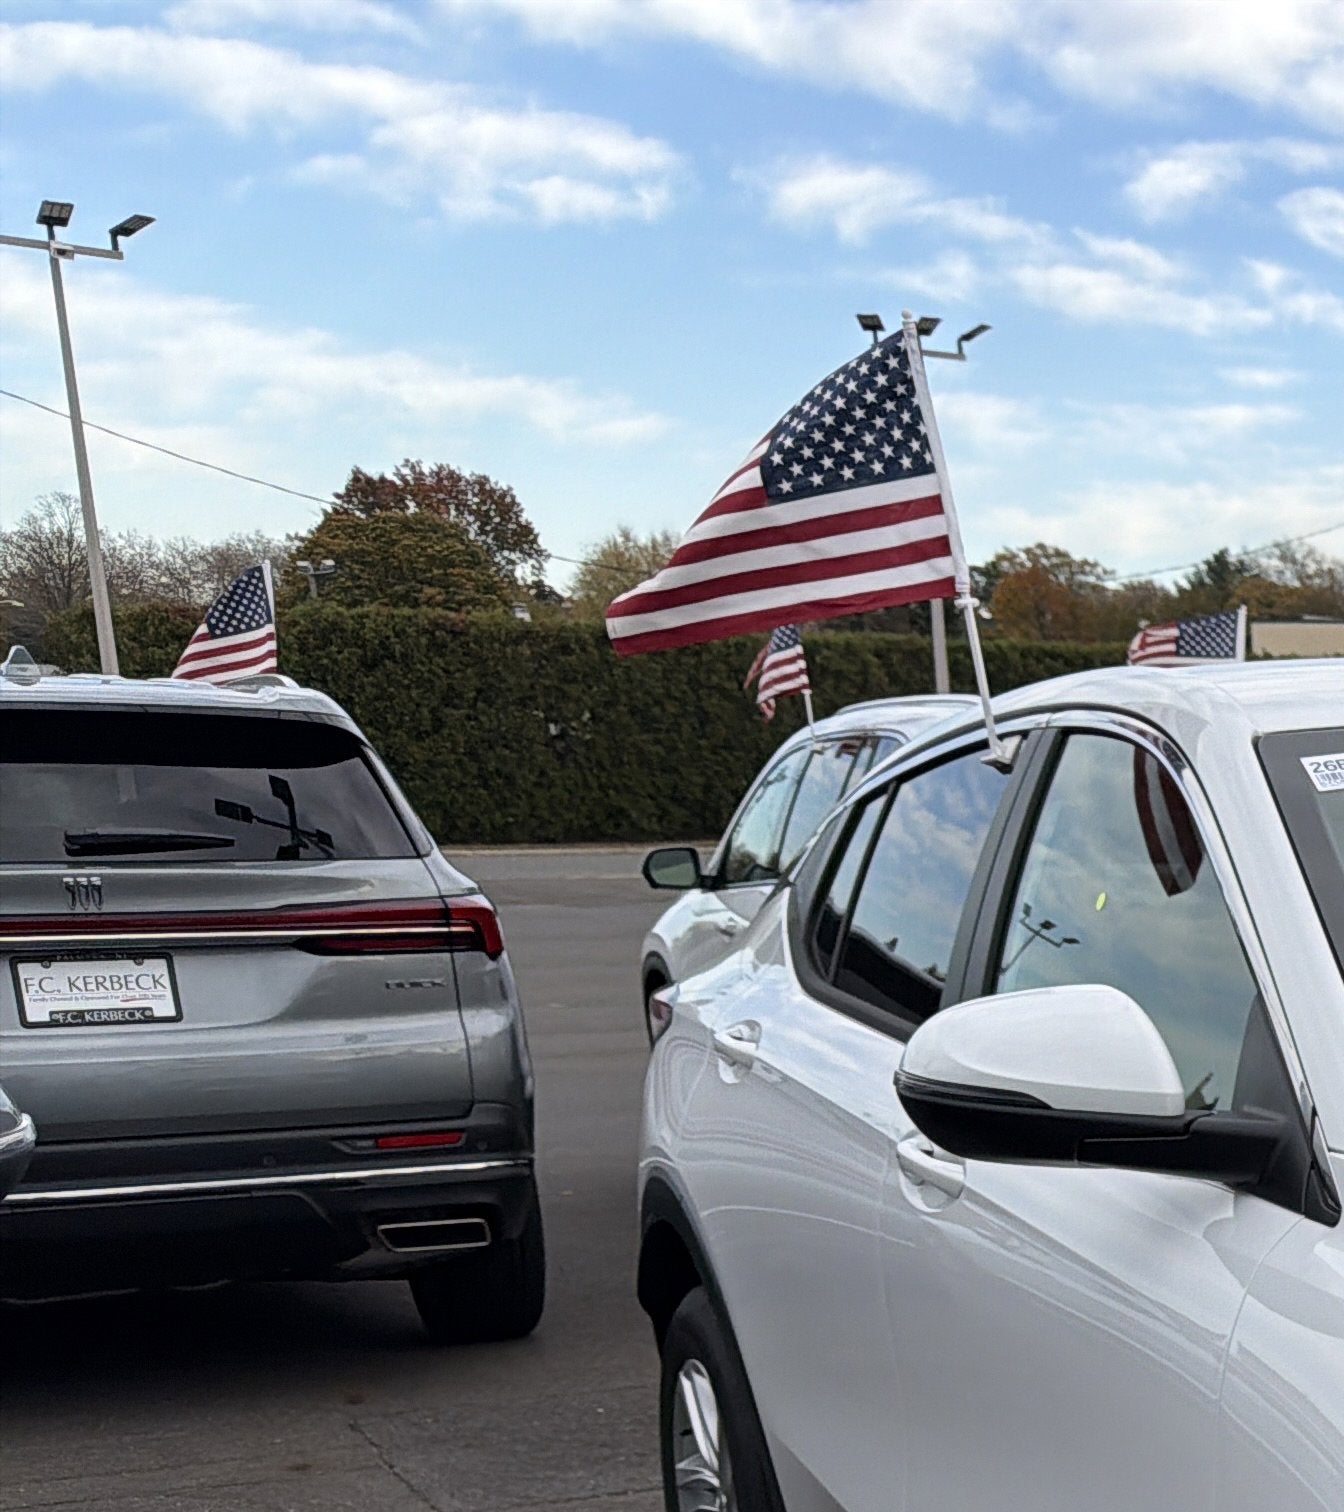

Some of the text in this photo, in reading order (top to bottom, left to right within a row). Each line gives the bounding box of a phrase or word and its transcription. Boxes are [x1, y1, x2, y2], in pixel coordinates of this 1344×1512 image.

[24, 973, 167, 994] F.C. KERBECK
[84, 1009, 145, 1022] KERBECK
